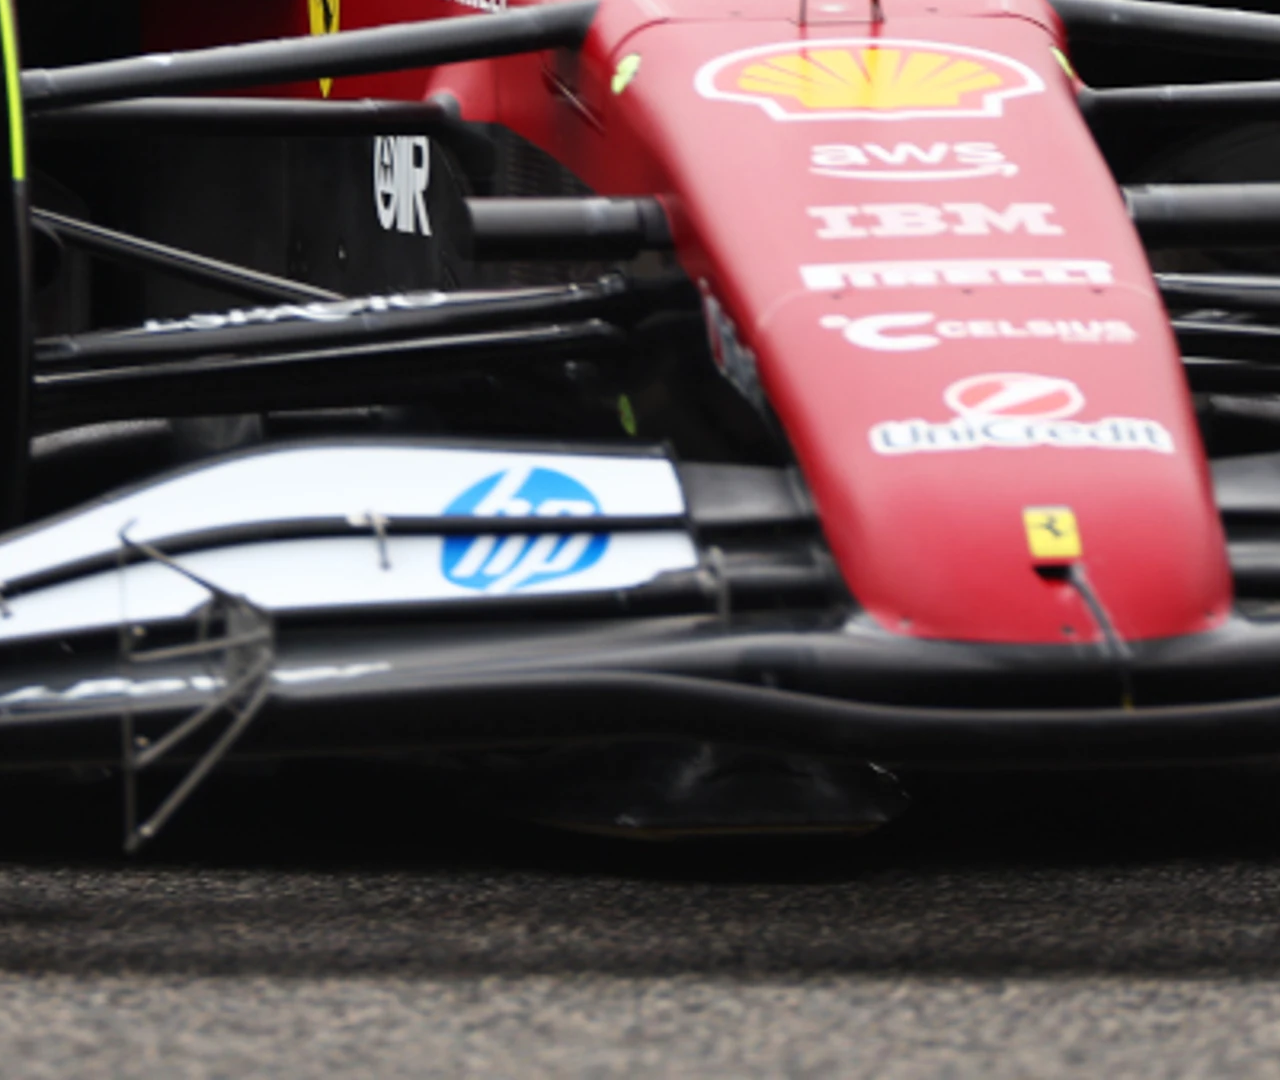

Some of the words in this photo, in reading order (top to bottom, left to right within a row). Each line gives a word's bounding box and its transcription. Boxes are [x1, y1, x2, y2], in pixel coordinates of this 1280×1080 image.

[809, 141, 1010, 170] aws
[806, 201, 1066, 240] IBM
[880, 419, 1168, 452] UniCredit
[448, 467, 600, 593] hp
